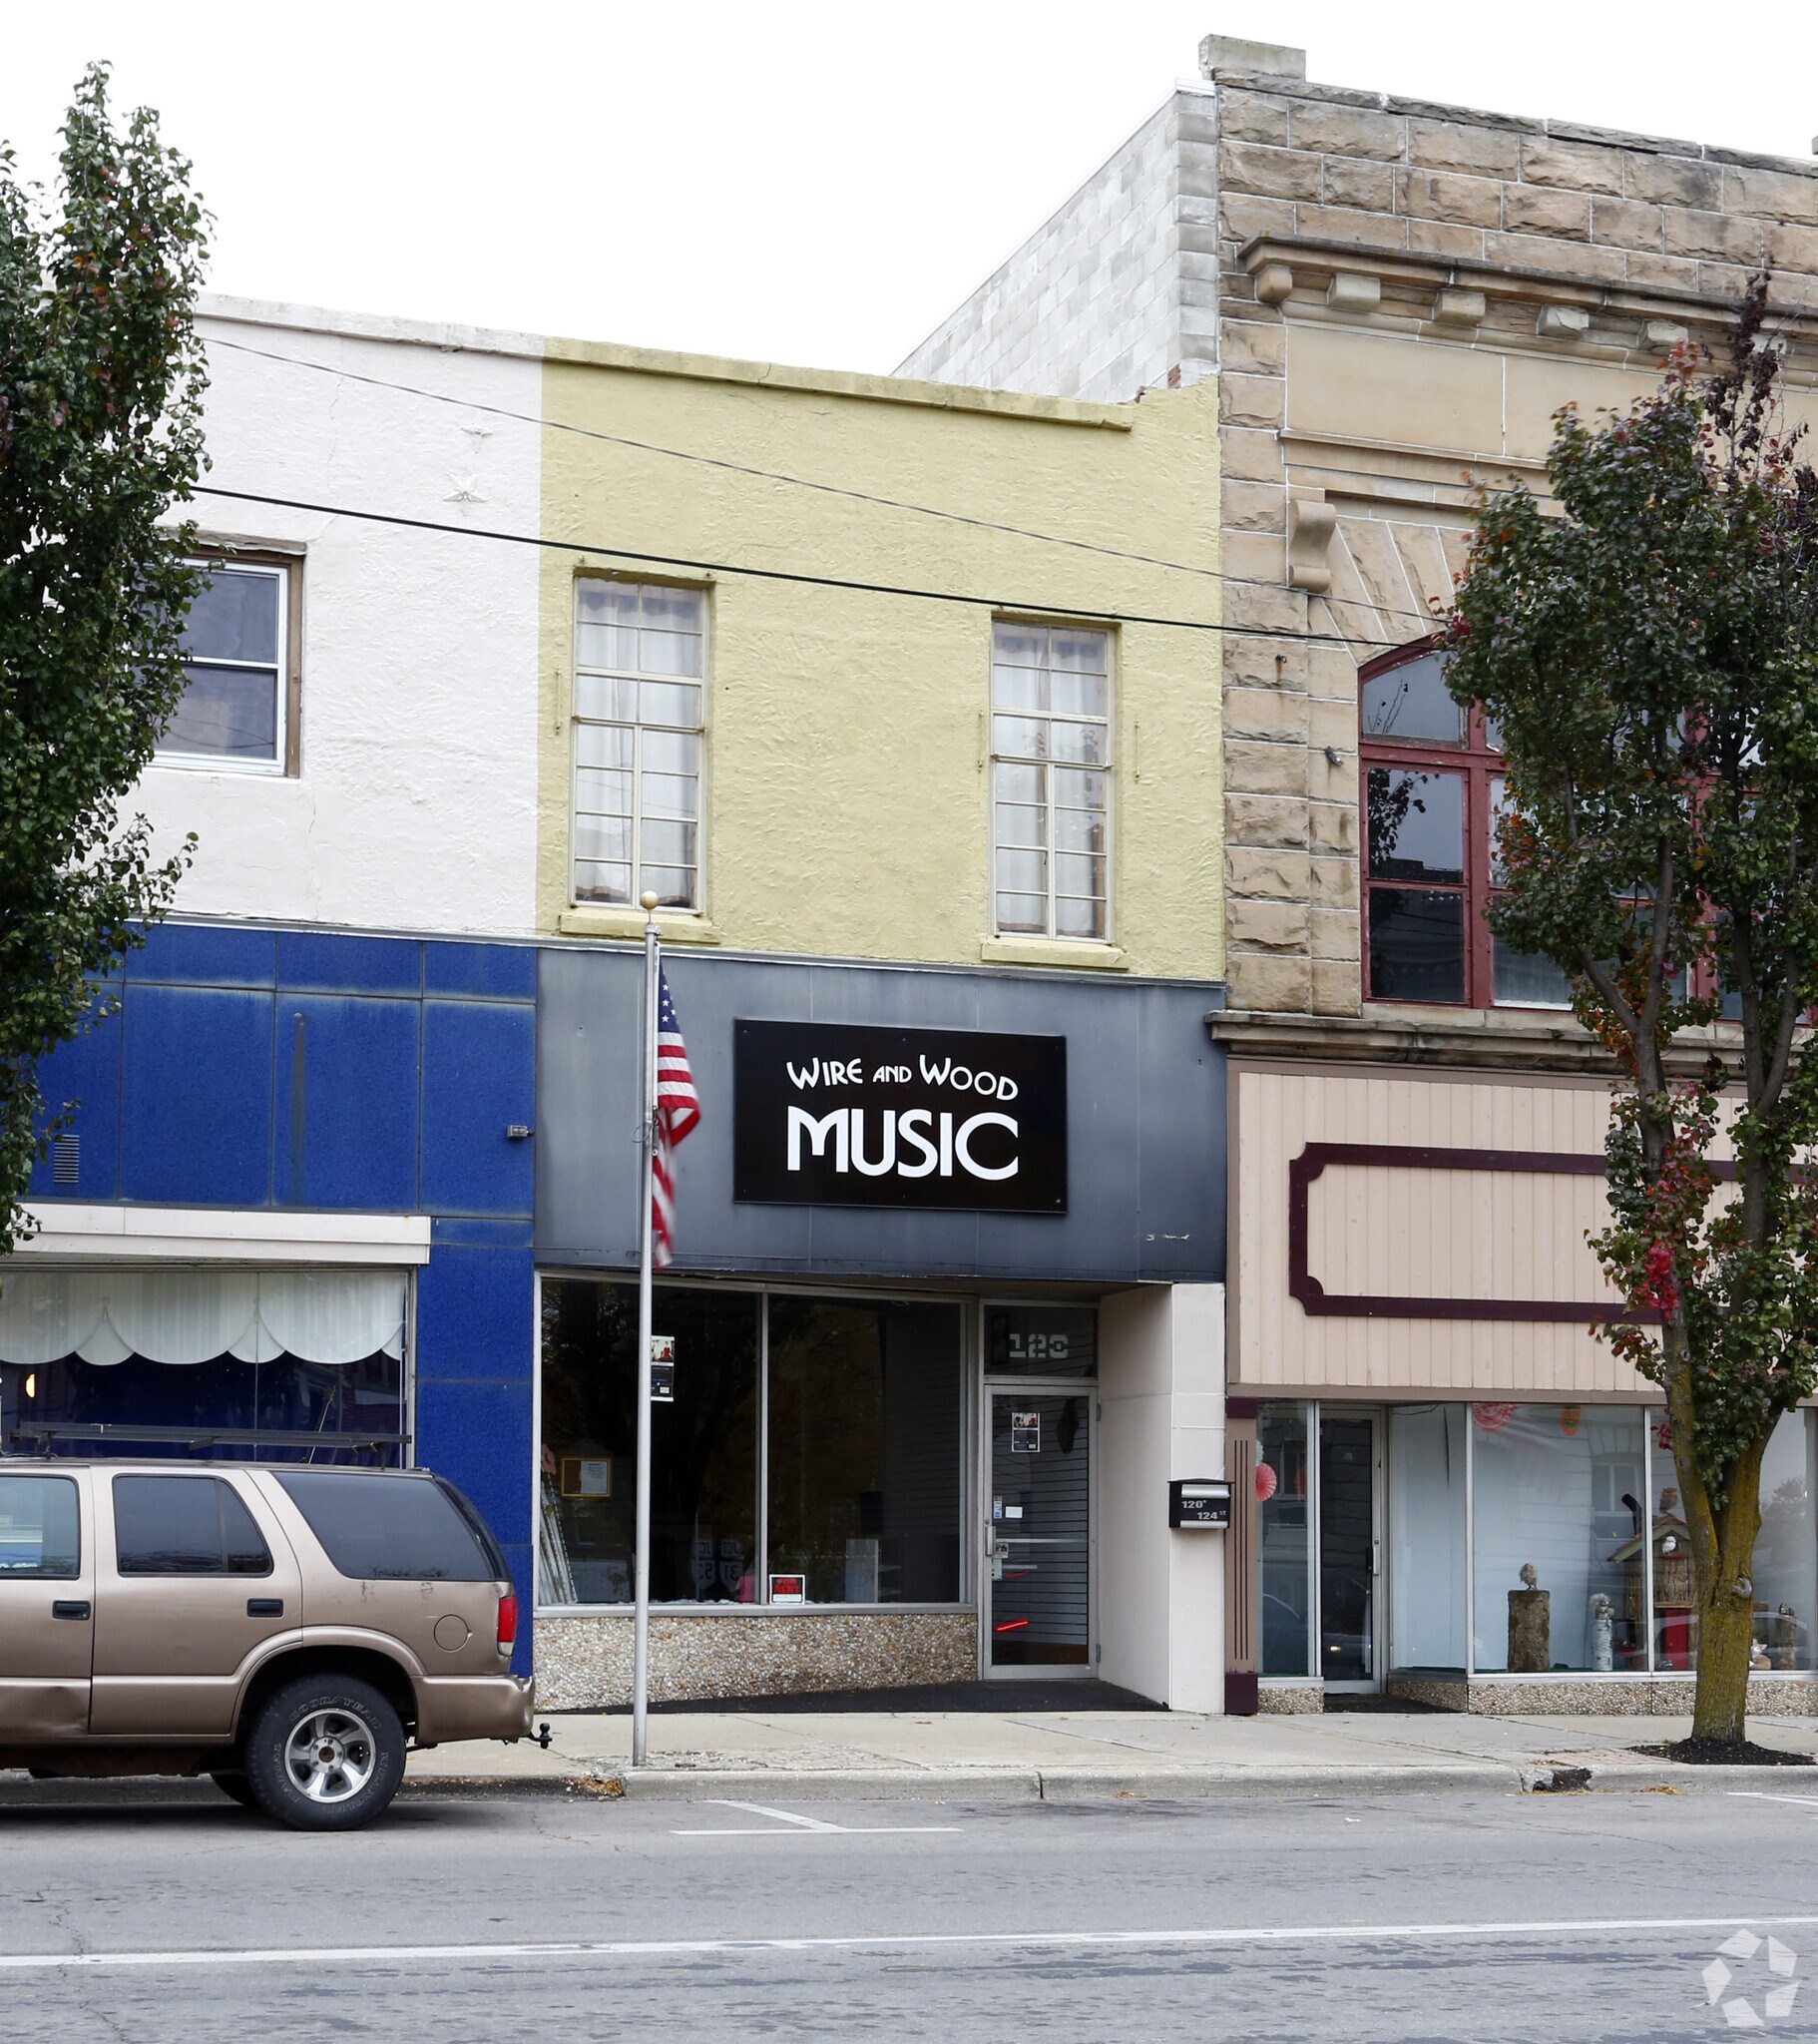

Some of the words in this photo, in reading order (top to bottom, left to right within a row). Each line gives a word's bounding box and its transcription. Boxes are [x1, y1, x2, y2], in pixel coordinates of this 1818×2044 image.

[786, 1057, 863, 1090] WIRE
[872, 1065, 912, 1084] AND
[919, 1054, 1019, 1101] WOOD
[787, 1105, 1019, 1181] MUSIC
[1009, 1333, 1069, 1358] 120
[774, 1585, 799, 1594] RENT
